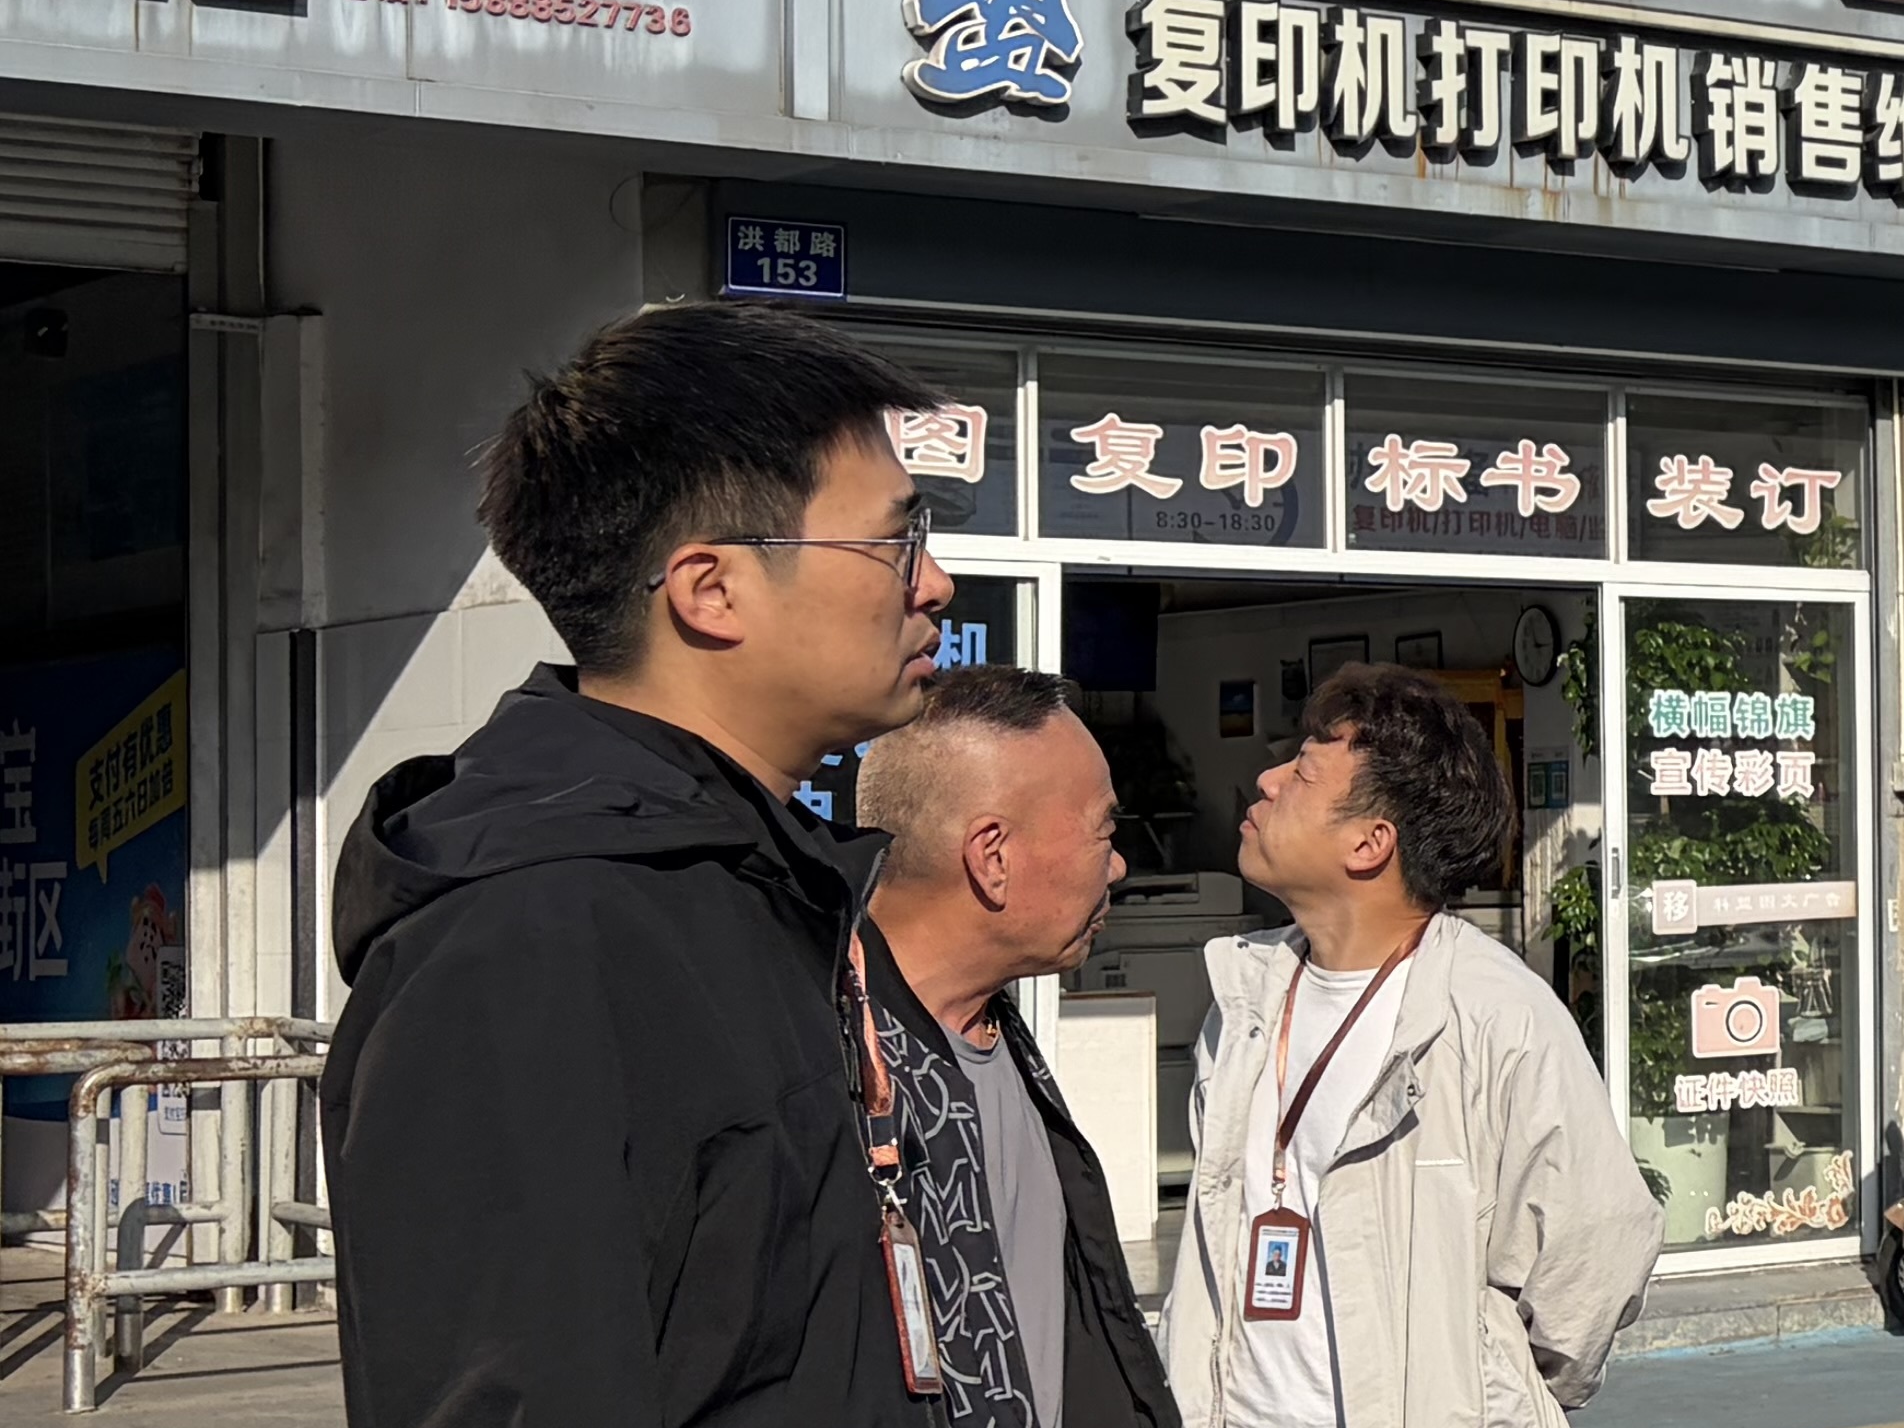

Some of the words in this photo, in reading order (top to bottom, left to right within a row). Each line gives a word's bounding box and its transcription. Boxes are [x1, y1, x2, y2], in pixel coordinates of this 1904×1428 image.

[737, 225, 837, 258] 洪都路
[757, 257, 817, 286] 153
[1070, 413, 1298, 508] 复印
[1366, 434, 1581, 517] 标书
[1646, 453, 1842, 535] 装订
[1649, 690, 1816, 739] 横幅锦旗
[89, 701, 173, 812] 支付有优惠
[1649, 750, 1816, 798] 宣传彩页
[1674, 1067, 1799, 1114] 证件快照
